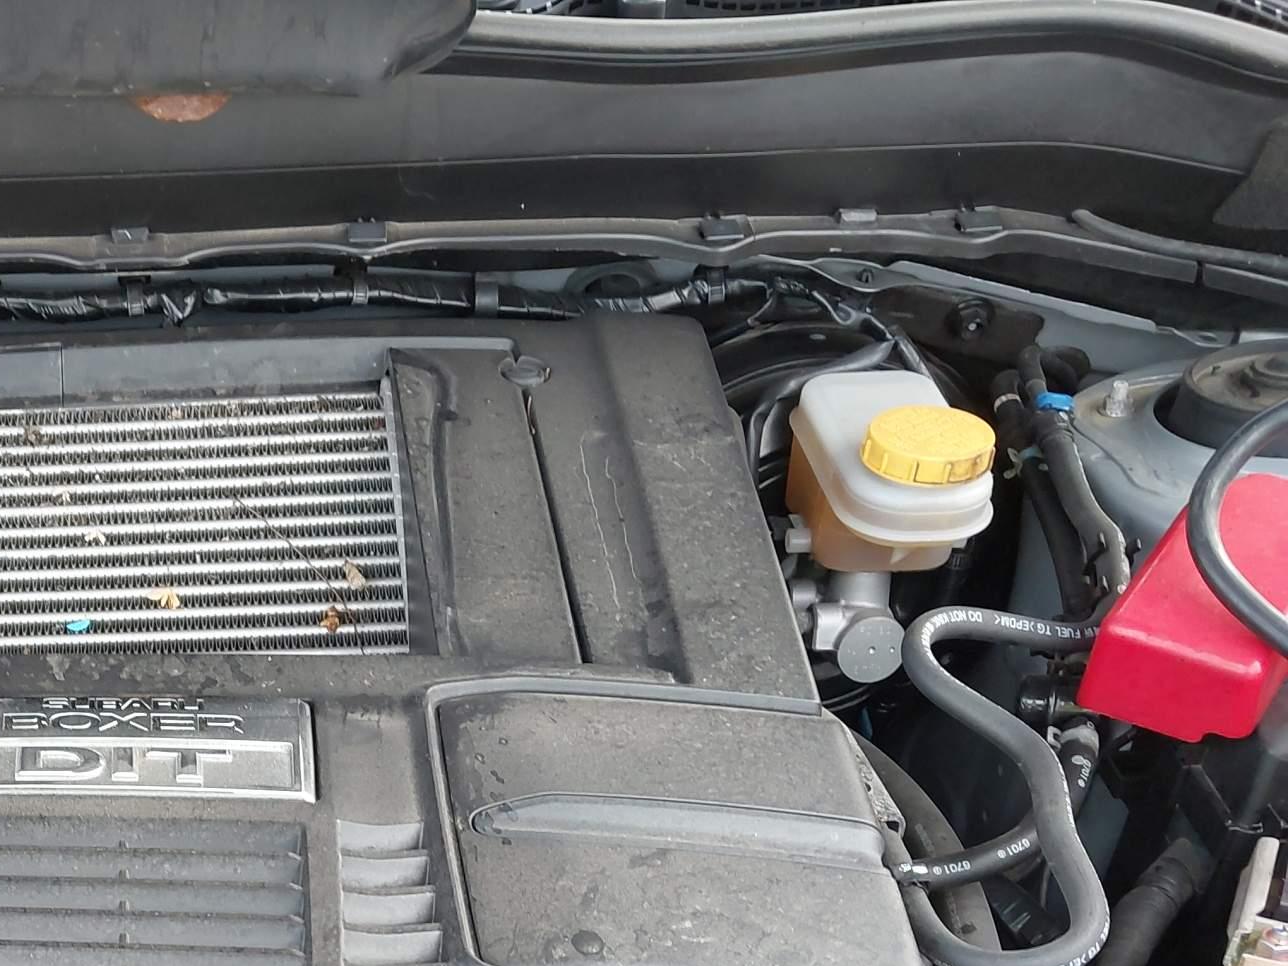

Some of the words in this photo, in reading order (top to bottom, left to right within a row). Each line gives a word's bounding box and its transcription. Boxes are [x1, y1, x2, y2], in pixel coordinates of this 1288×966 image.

[43, 697, 204, 710] SUBARU
[1, 712, 244, 734] BOXER
[15, 747, 233, 787] DIT
